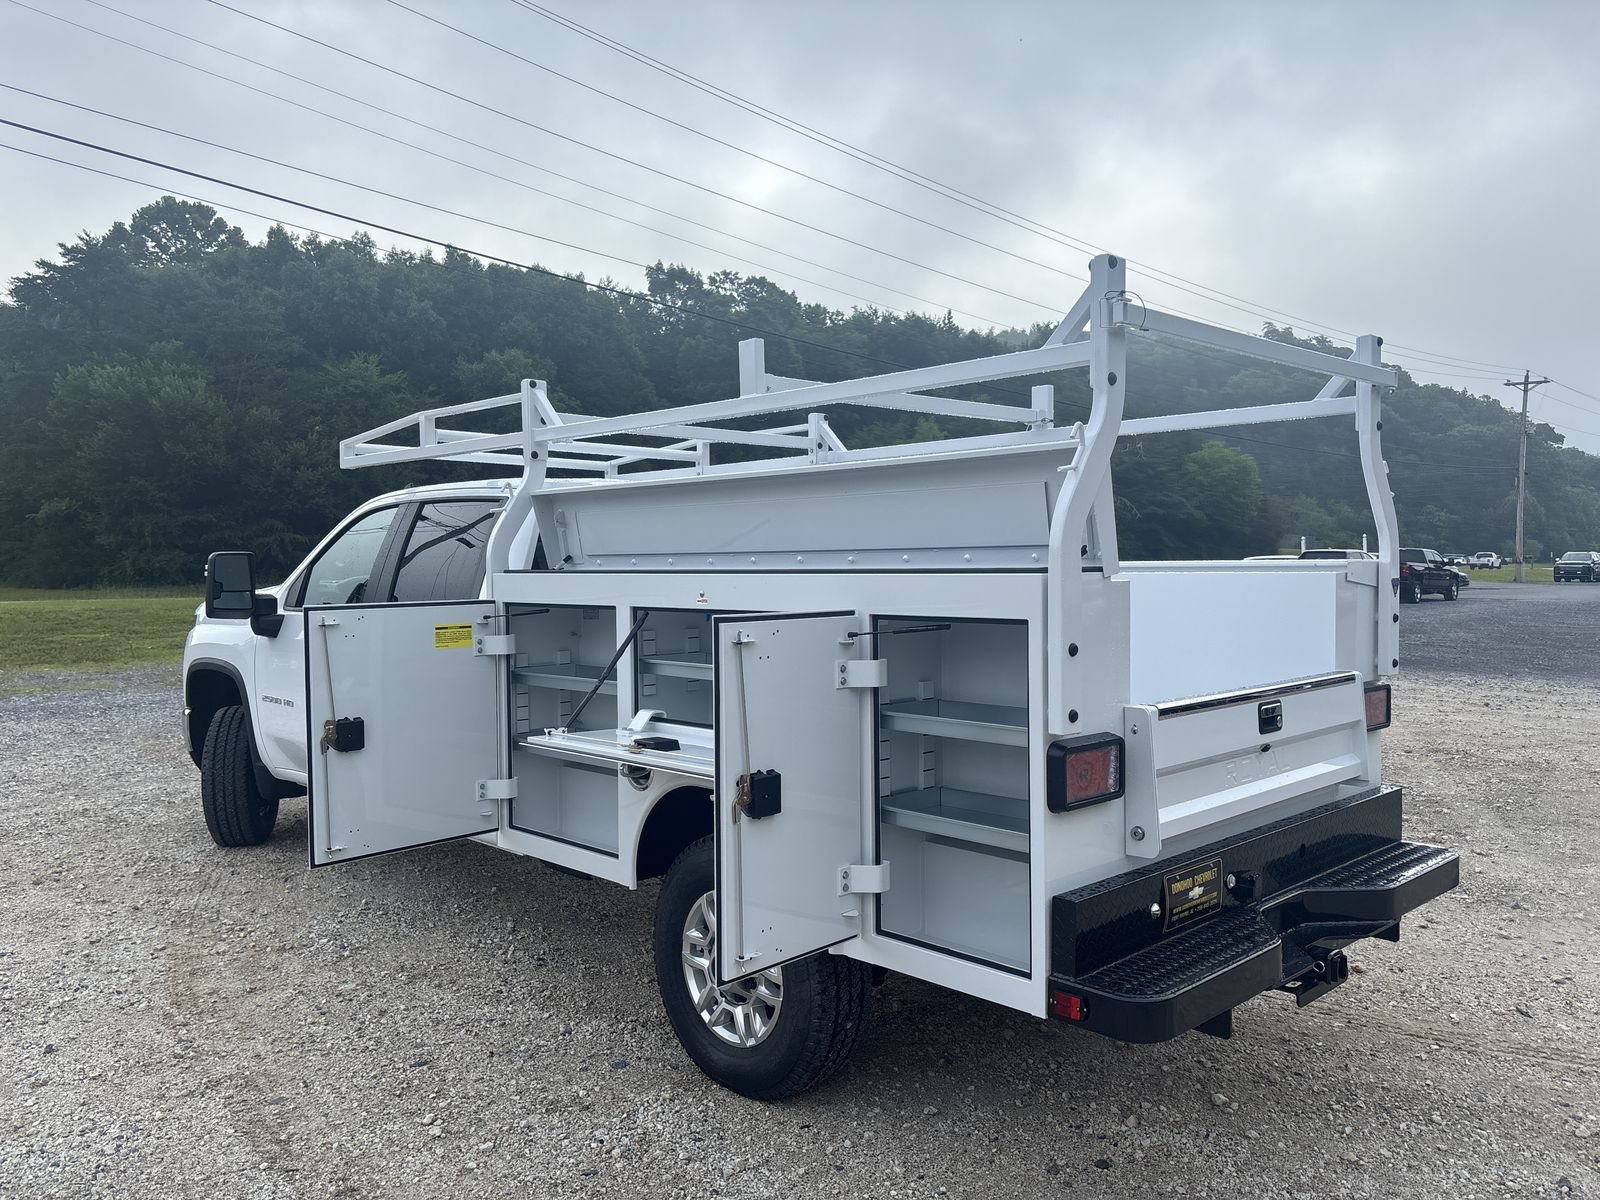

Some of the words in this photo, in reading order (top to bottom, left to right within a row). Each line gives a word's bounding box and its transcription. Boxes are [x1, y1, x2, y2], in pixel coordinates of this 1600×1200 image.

[261, 694, 281, 705] 2500
[283, 698, 294, 708] HD
[1194, 867, 1217, 886] CHEVROLET
